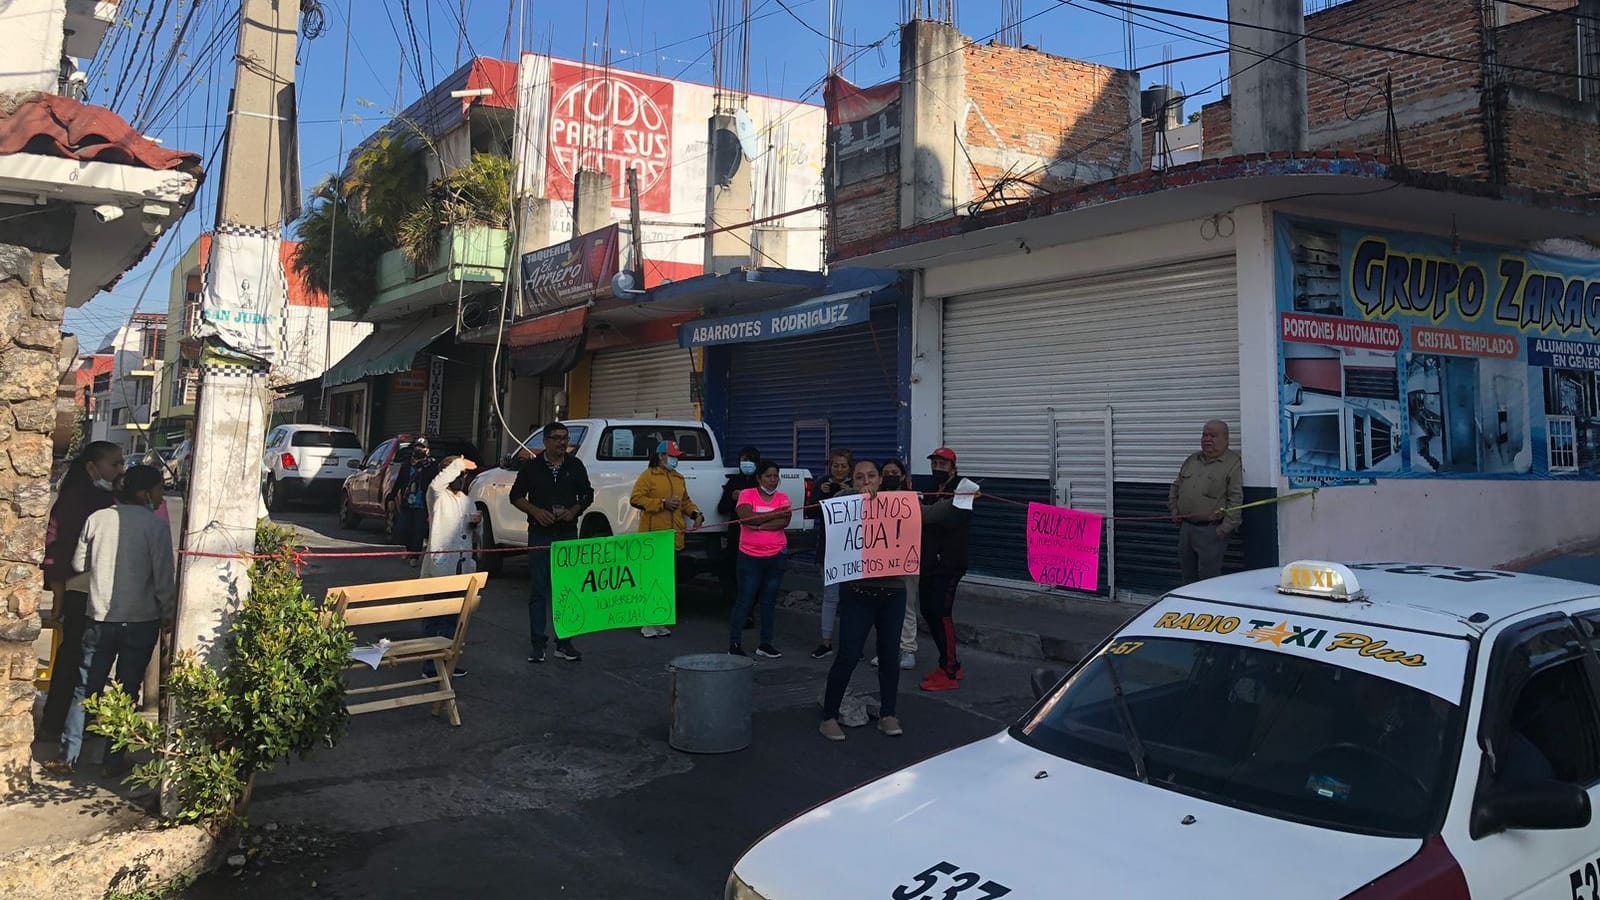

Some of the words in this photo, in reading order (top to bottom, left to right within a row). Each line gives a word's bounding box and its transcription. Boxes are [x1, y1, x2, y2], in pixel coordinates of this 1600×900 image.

[557, 79, 662, 130] TODO
[553, 118, 613, 151] PARA
[623, 130, 667, 158] SUS
[527, 243, 571, 264] TAQUERIA
[525, 264, 582, 289] Arriero
[1353, 240, 1485, 321] GRUPO
[692, 321, 761, 342] ABARROTES
[771, 303, 849, 333] RODRIGUEZ
[1283, 318, 1333, 340] PORTONES
[1336, 323, 1399, 346] AUTOMATICOS
[1417, 331, 1458, 350] CRISTAL
[1459, 335, 1514, 354] TEMPLADO
[1535, 339, 1585, 354] ALUMINIO
[1586, 344, 1593, 355] Y
[1553, 354, 1566, 367] EN
[557, 538, 655, 567] QUEREMOS
[826, 566, 838, 581] NO
[842, 559, 883, 573] TENEMOS
[888, 558, 900, 569] NI
[1289, 567, 1334, 589] TAXI
[1153, 612, 1241, 634] RADIO
[1325, 632, 1427, 667] Plus
